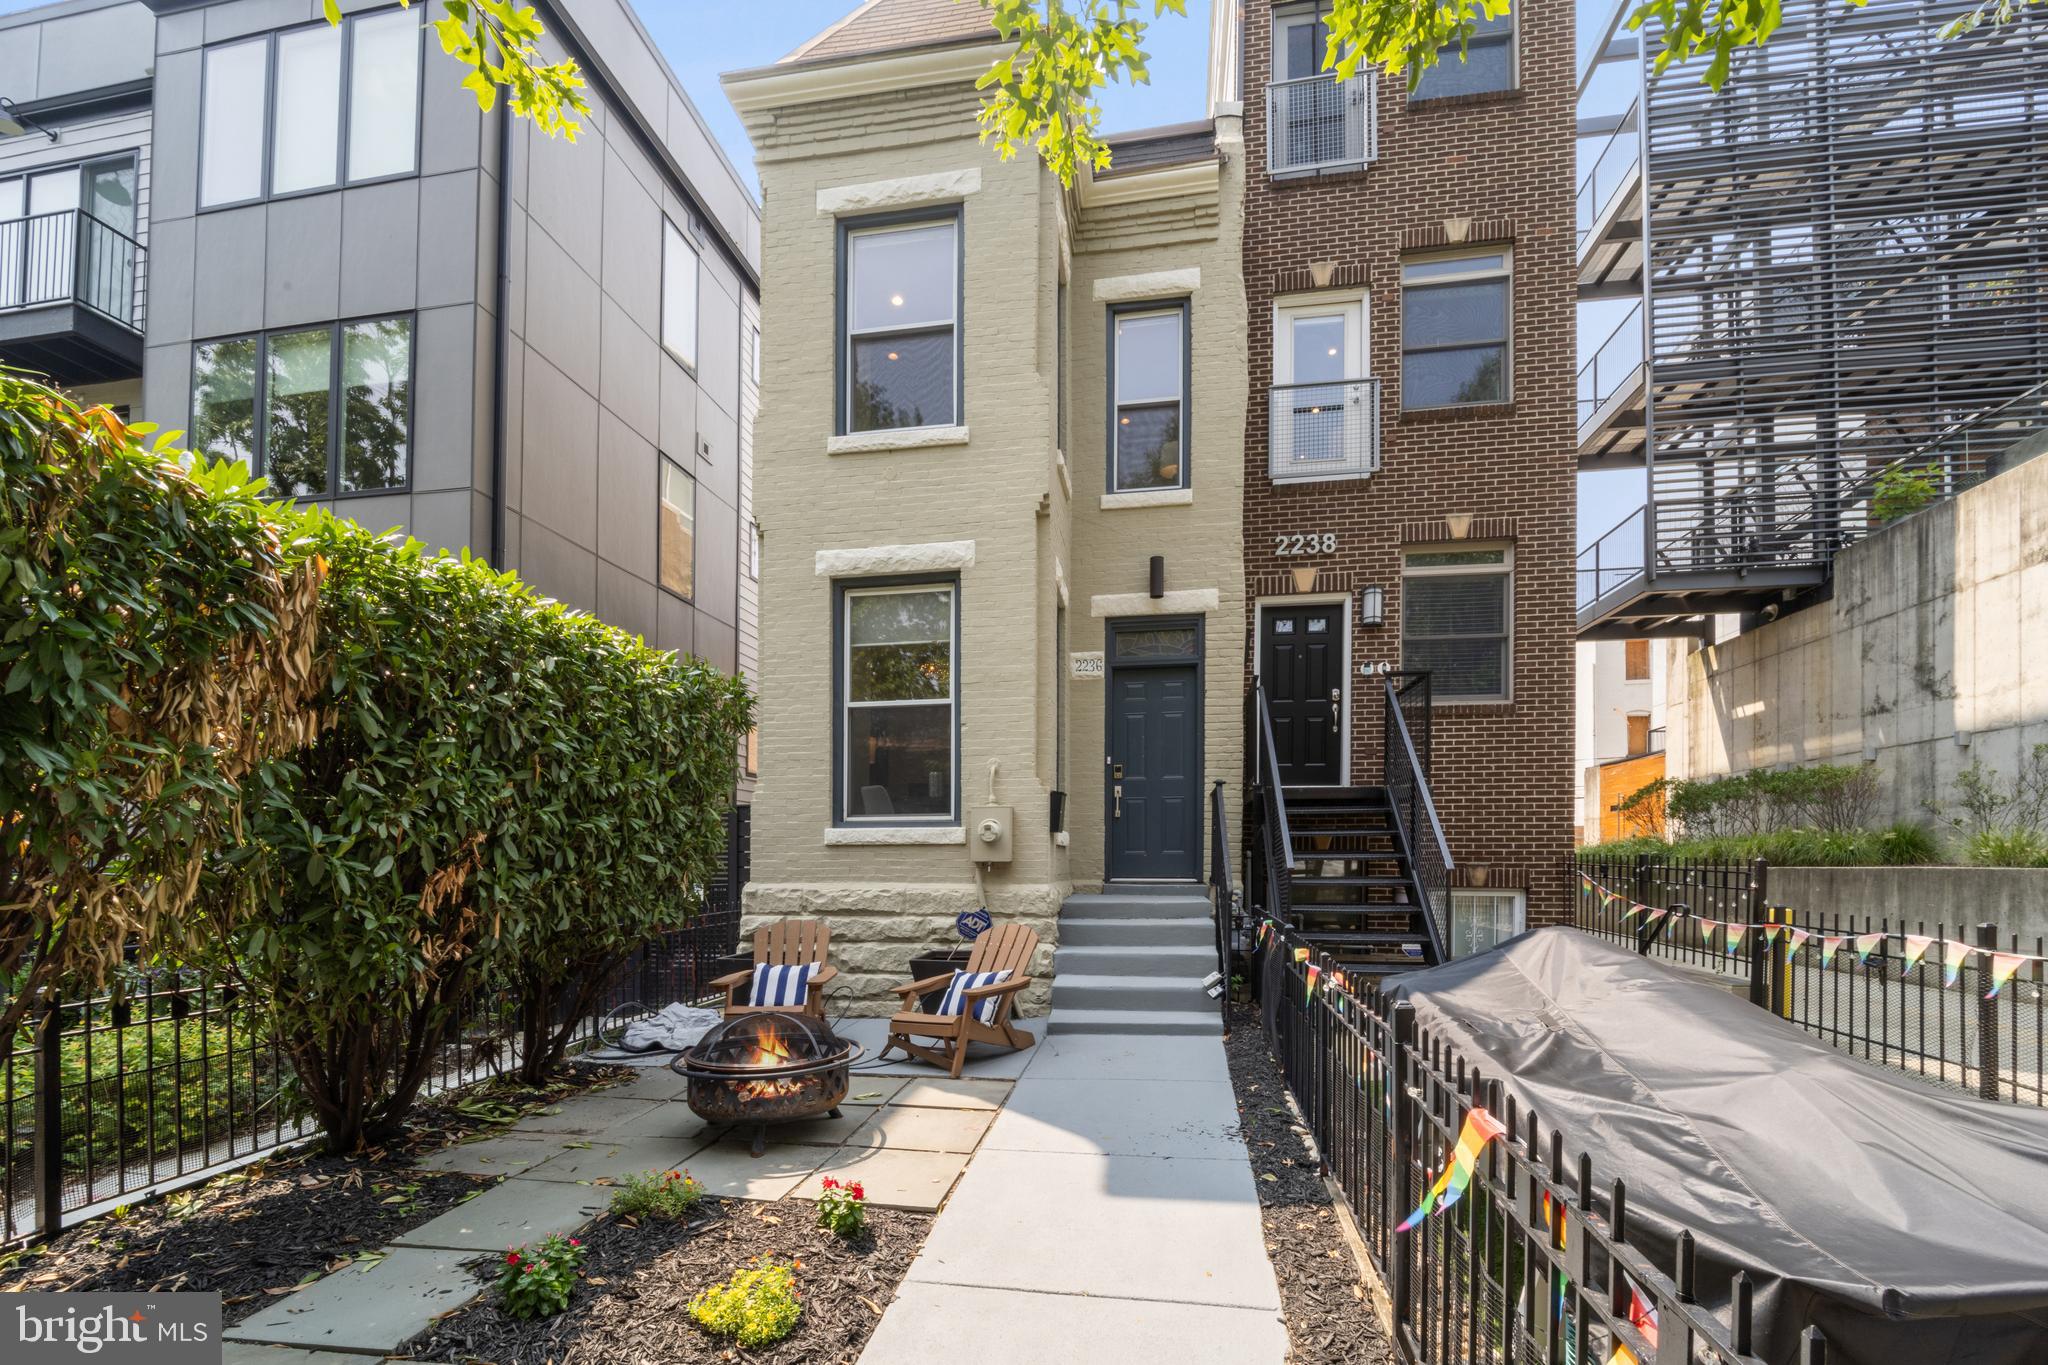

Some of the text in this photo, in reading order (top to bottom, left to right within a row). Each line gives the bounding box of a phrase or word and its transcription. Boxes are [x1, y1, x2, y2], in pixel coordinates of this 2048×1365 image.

[1275, 533, 1336, 556] 2238
[1075, 658, 1103, 672] 2236
[961, 915, 986, 932] ADT
